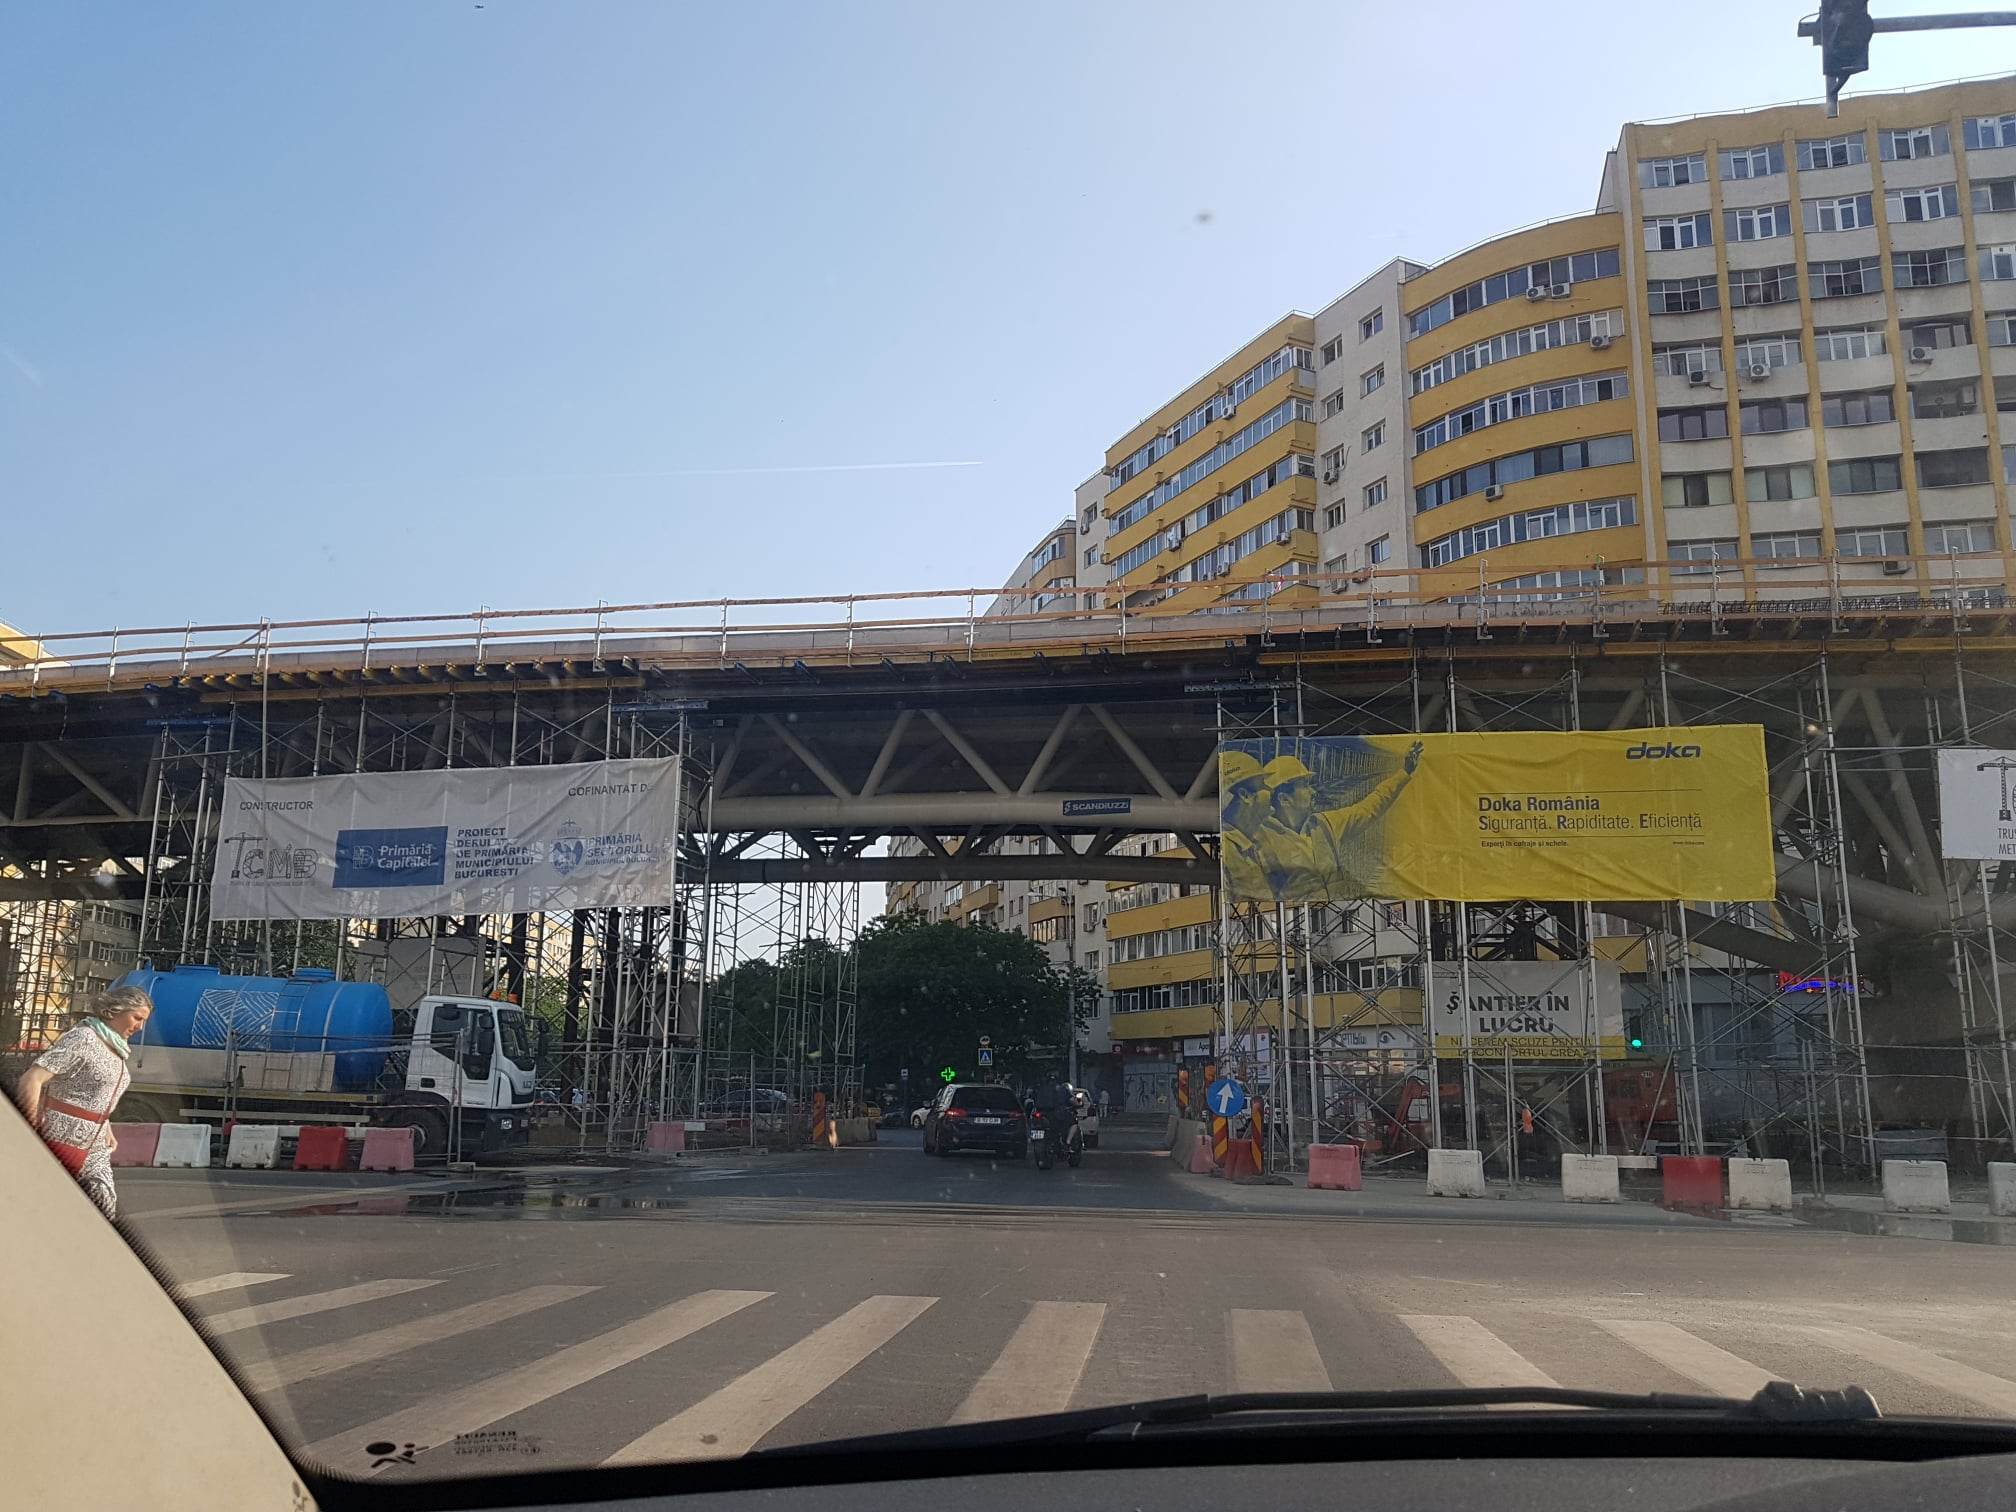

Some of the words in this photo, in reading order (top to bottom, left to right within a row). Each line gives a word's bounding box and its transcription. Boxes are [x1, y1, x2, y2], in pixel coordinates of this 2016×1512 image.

[1626, 742, 1701, 760] doka
[240, 801, 313, 811] CONTRUCTOR
[1479, 797, 1521, 812] Doka
[1527, 795, 1600, 811] România
[1556, 814, 1634, 832] Rapiditate.
[379, 844, 432, 856] Primăria
[1480, 1017, 1554, 1033] LUCRU
